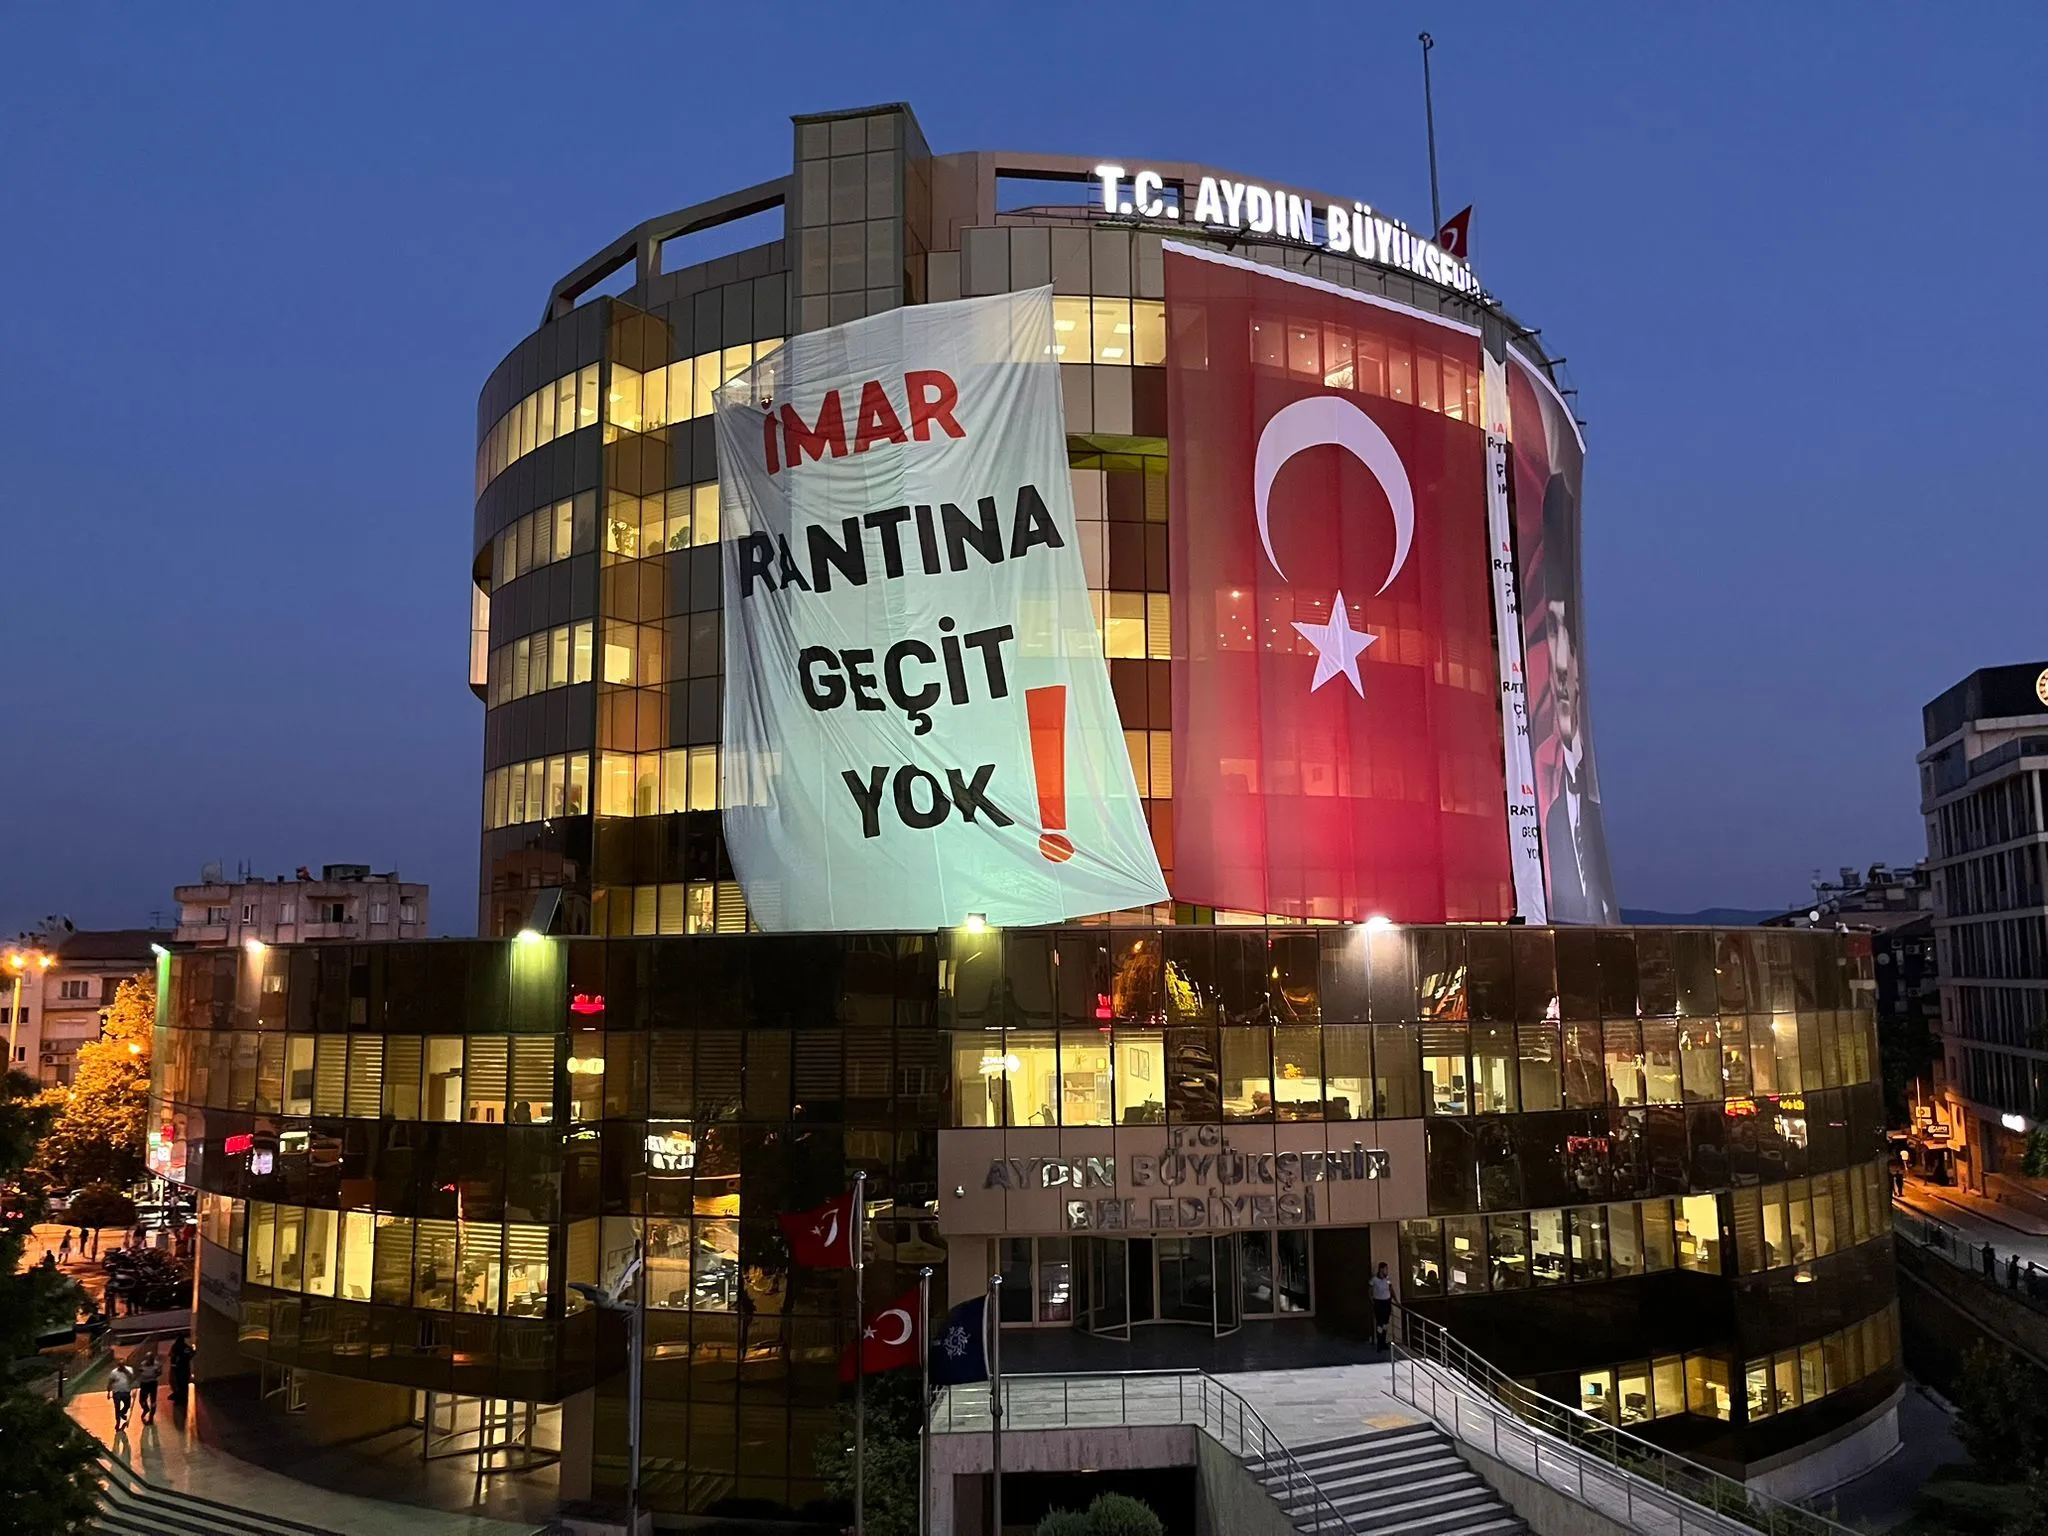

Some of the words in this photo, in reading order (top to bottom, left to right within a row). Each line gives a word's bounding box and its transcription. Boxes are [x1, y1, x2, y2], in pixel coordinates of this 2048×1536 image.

[1096, 165, 1179, 219] T.C.
[1194, 175, 1314, 244] AYDIN
[761, 369, 966, 475] İMAR
[739, 484, 1065, 599] RANTINA
[798, 616, 1014, 736] GEÇİT
[984, 1156, 1115, 1190] AYDIN
[1132, 1141, 1392, 1192] BÜYÜKŞEHİR
[1170, 1125, 1230, 1150] T.C.
[1067, 1186, 1316, 1230] BELEDİYESİ
